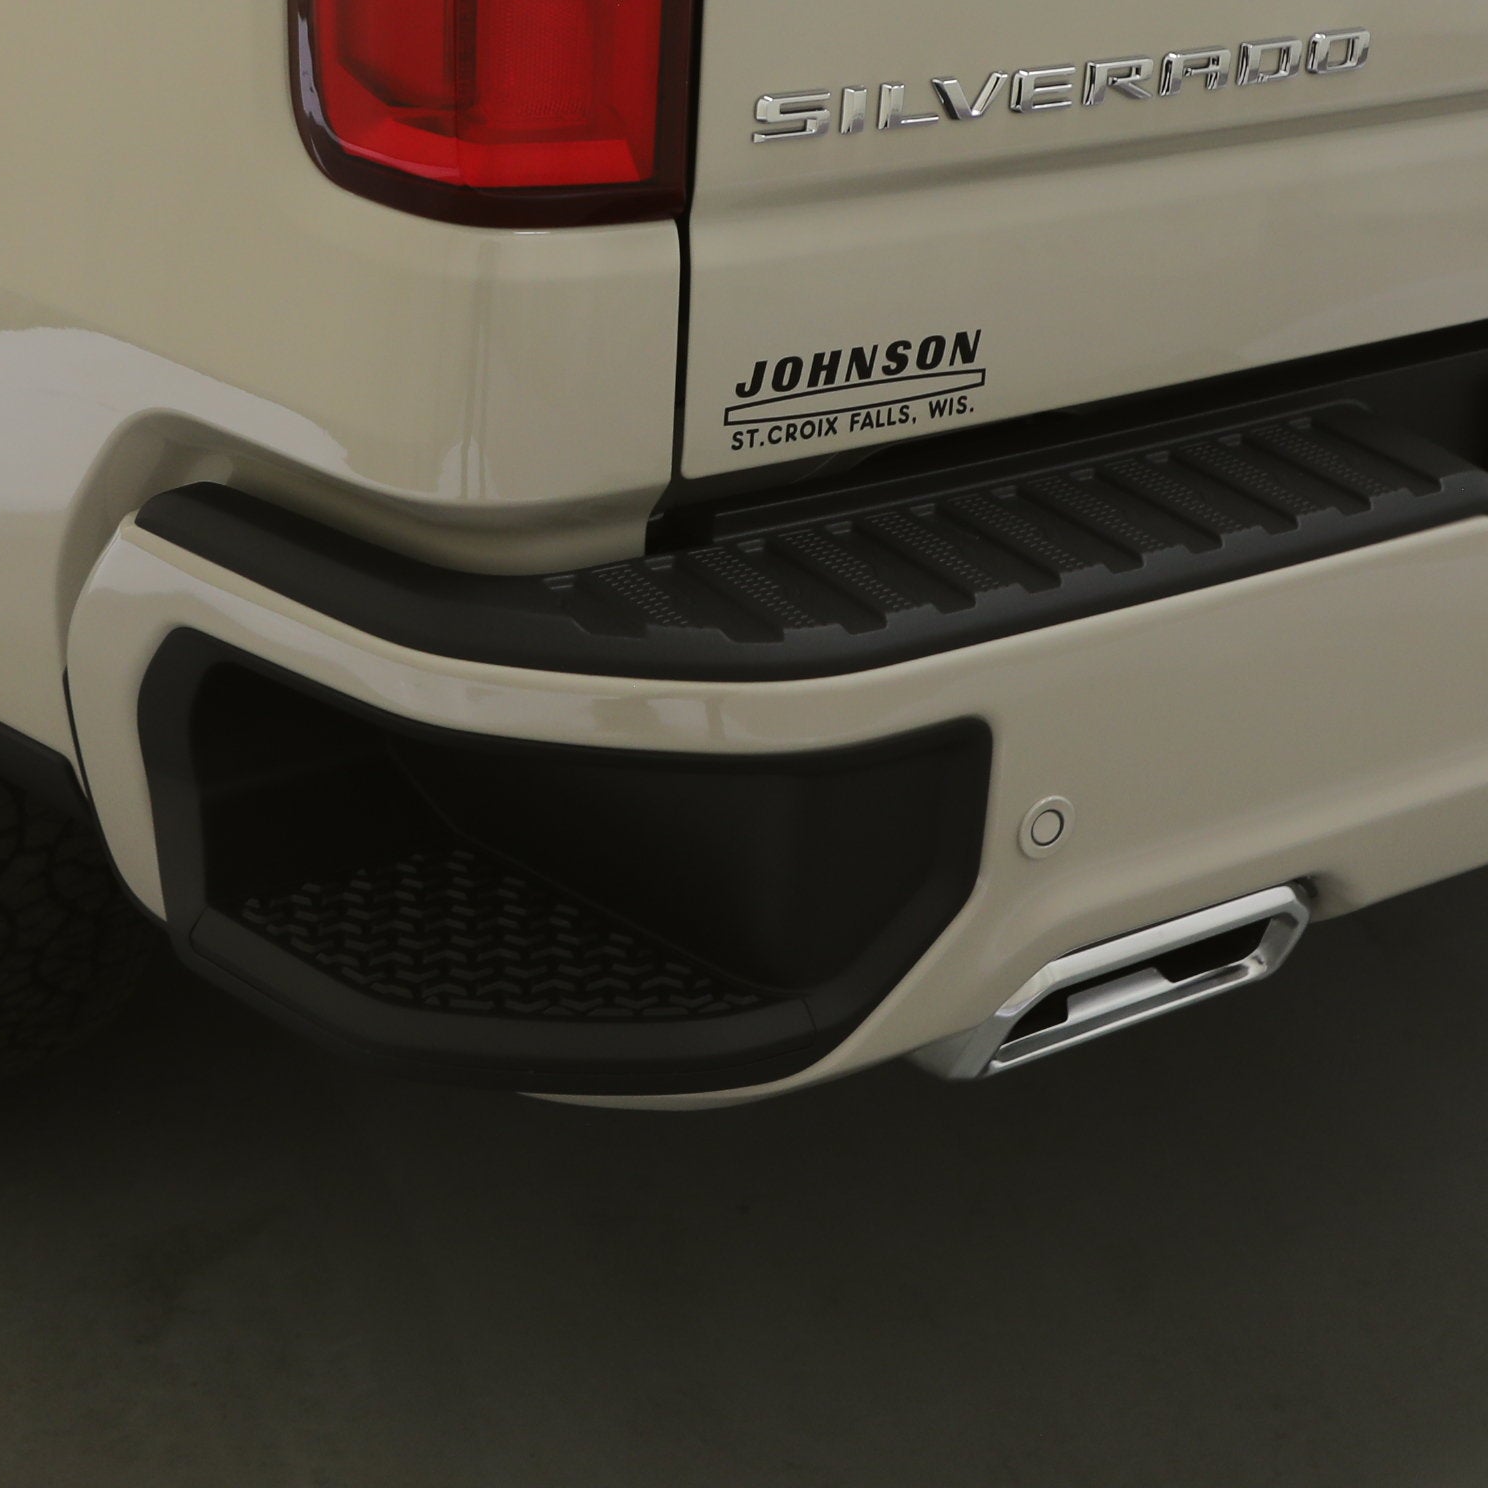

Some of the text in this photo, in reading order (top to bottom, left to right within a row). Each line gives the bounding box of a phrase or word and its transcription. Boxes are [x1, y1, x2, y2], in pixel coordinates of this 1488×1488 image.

[751, 25, 1371, 143] SILVERADO
[734, 328, 982, 399] JOHNSON
[849, 404, 917, 432] FALLS,
[928, 395, 974, 419] WIS.
